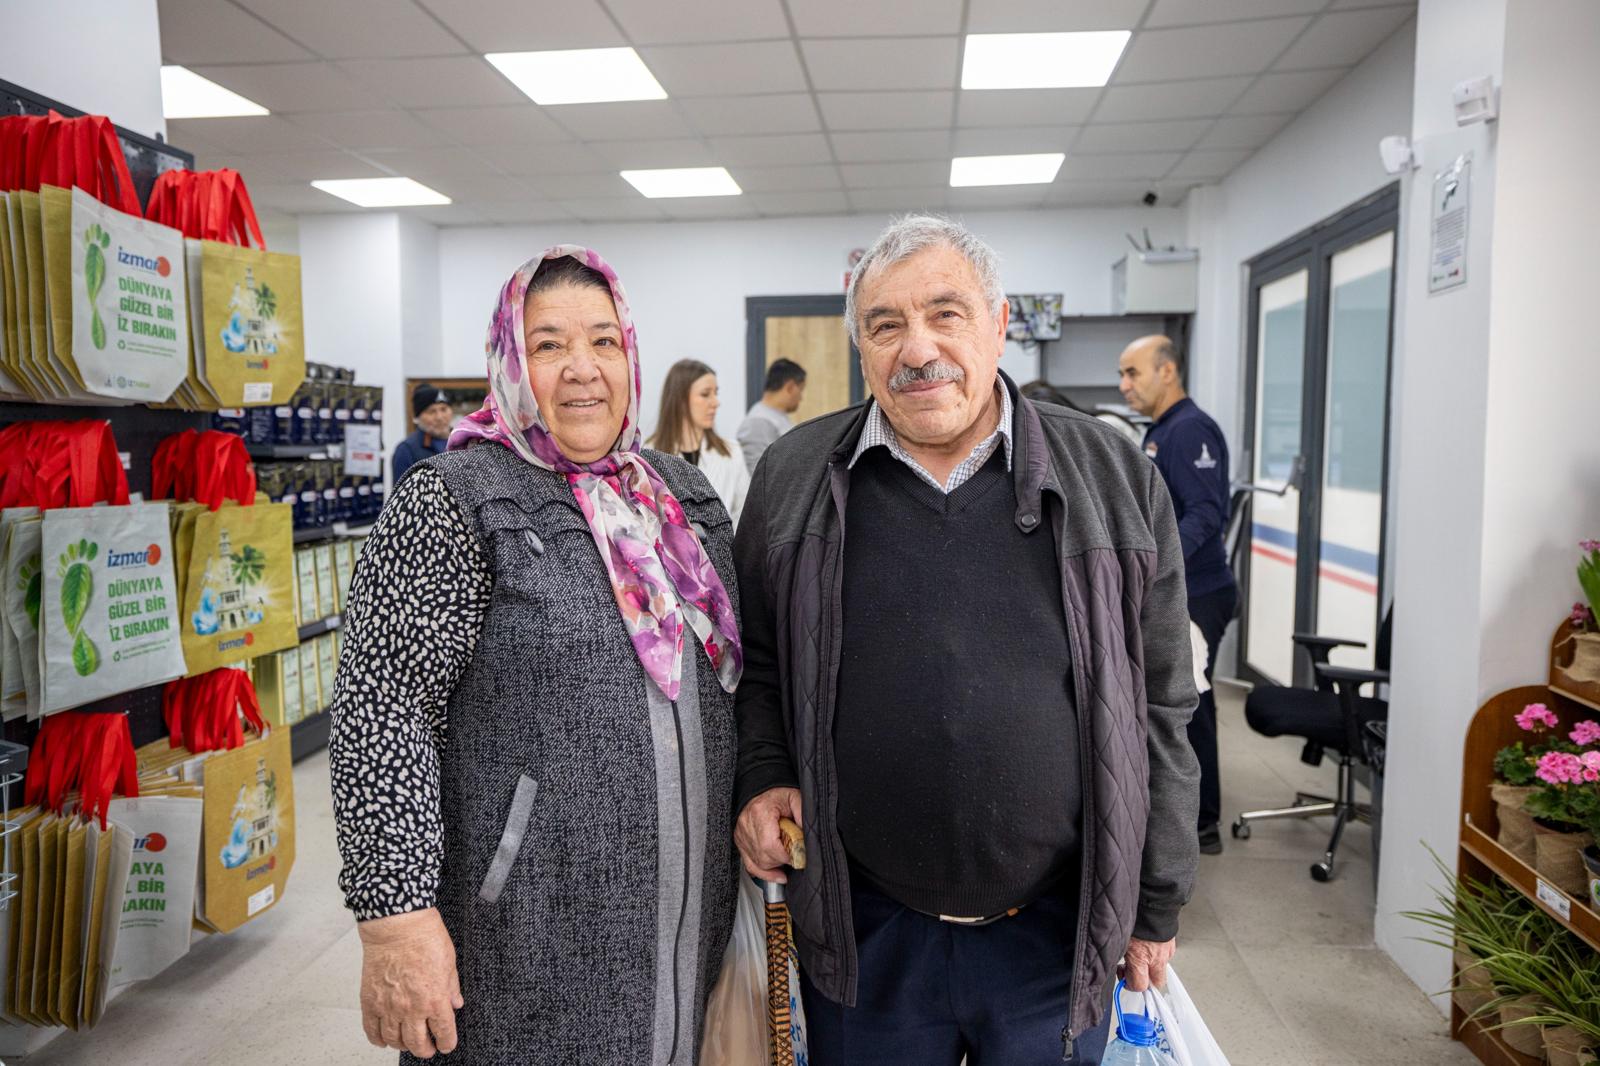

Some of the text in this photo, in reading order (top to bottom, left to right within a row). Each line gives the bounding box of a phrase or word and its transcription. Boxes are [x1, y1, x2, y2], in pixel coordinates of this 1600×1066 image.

[118, 276, 173, 301] DÜNYAYA
[120, 295, 174, 321] GÜZEL BİR
[117, 313, 176, 341] İZ BIRAKIN
[107, 549, 149, 568] izmar
[108, 576, 163, 598] DÜNYAYA
[108, 595, 166, 620] GÜZEL BİR
[109, 616, 170, 642] İZ BIRAKIN
[138, 877, 165, 893] BİR
